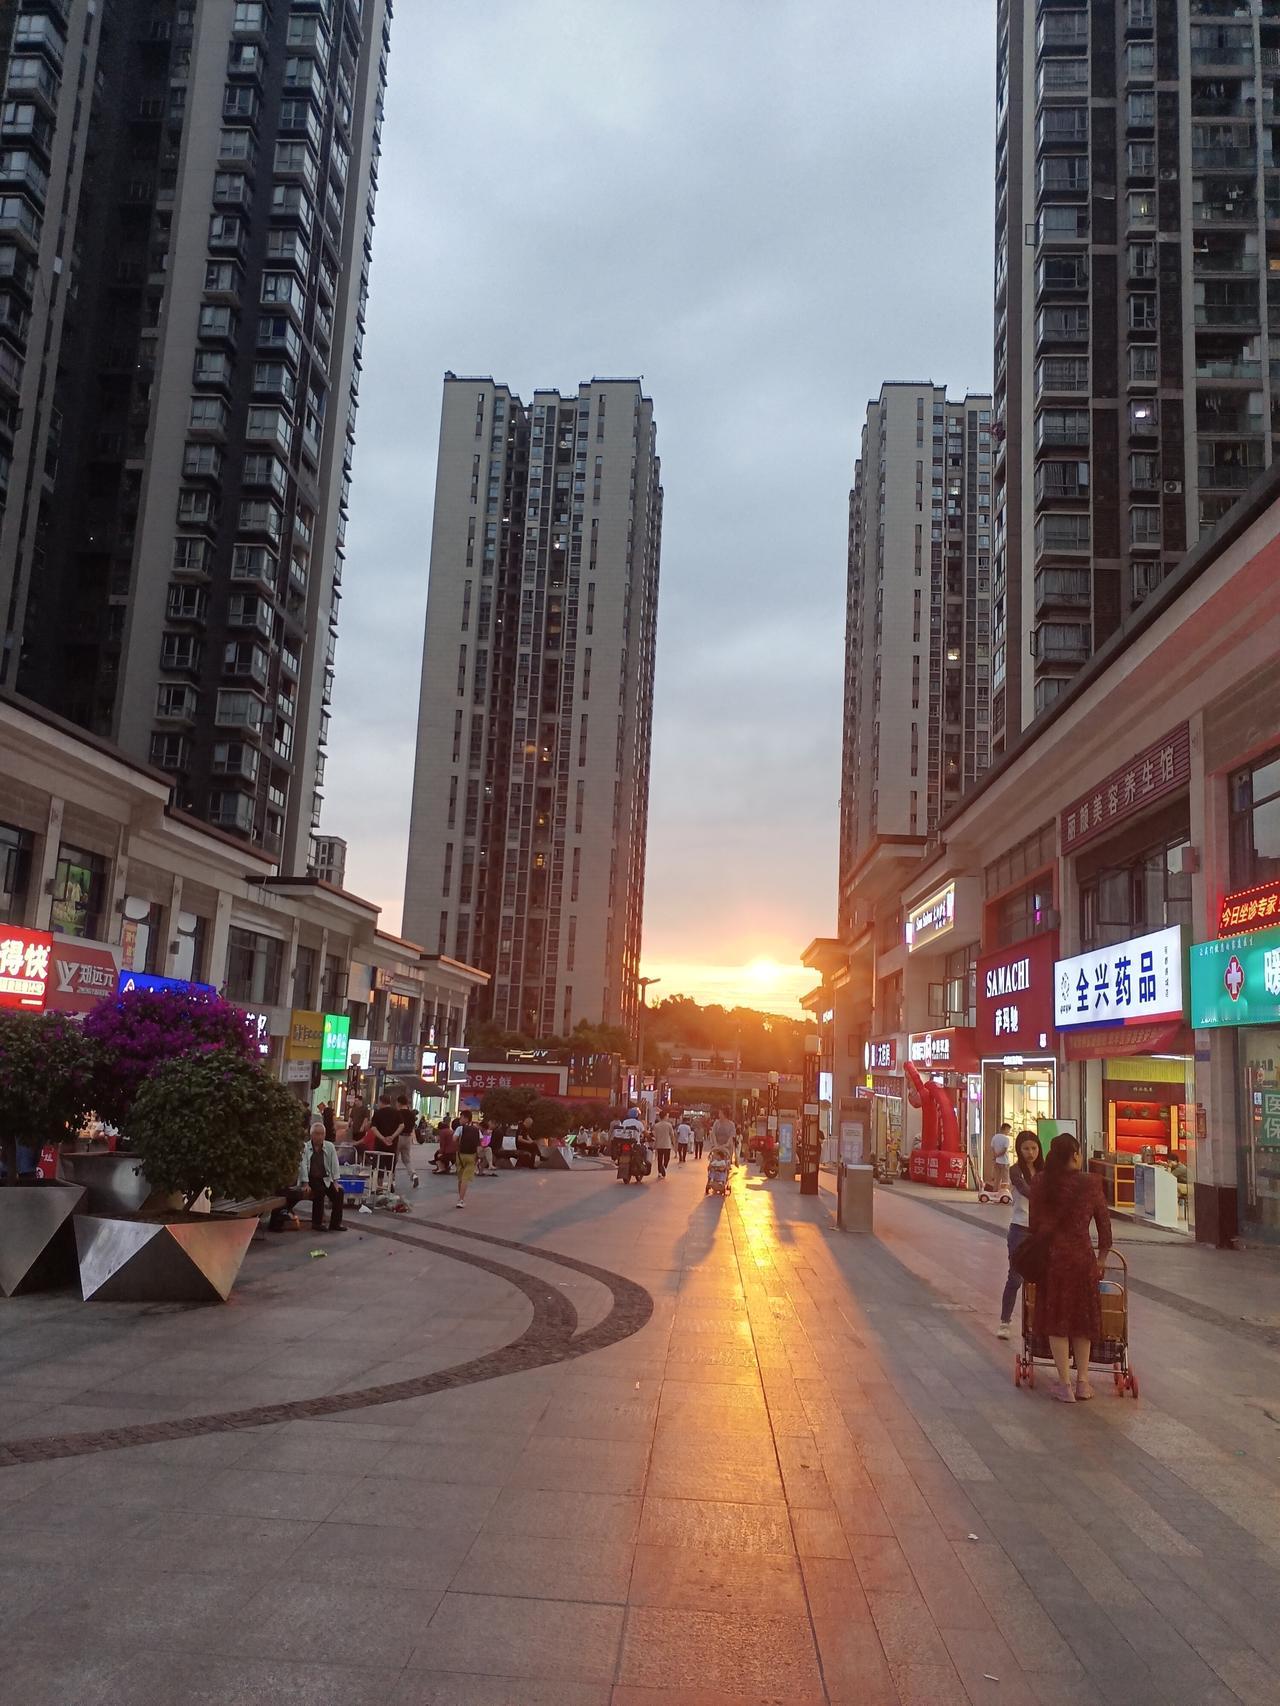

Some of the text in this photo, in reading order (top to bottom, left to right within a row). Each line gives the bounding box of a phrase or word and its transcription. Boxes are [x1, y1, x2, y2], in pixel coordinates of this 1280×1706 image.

[1067, 745, 1174, 842] 丽颜美容养生馆
[80, 964, 115, 988] 郑远元
[986, 958, 1030, 998] SAMACHI
[1076, 950, 1157, 1013] 全兴药品
